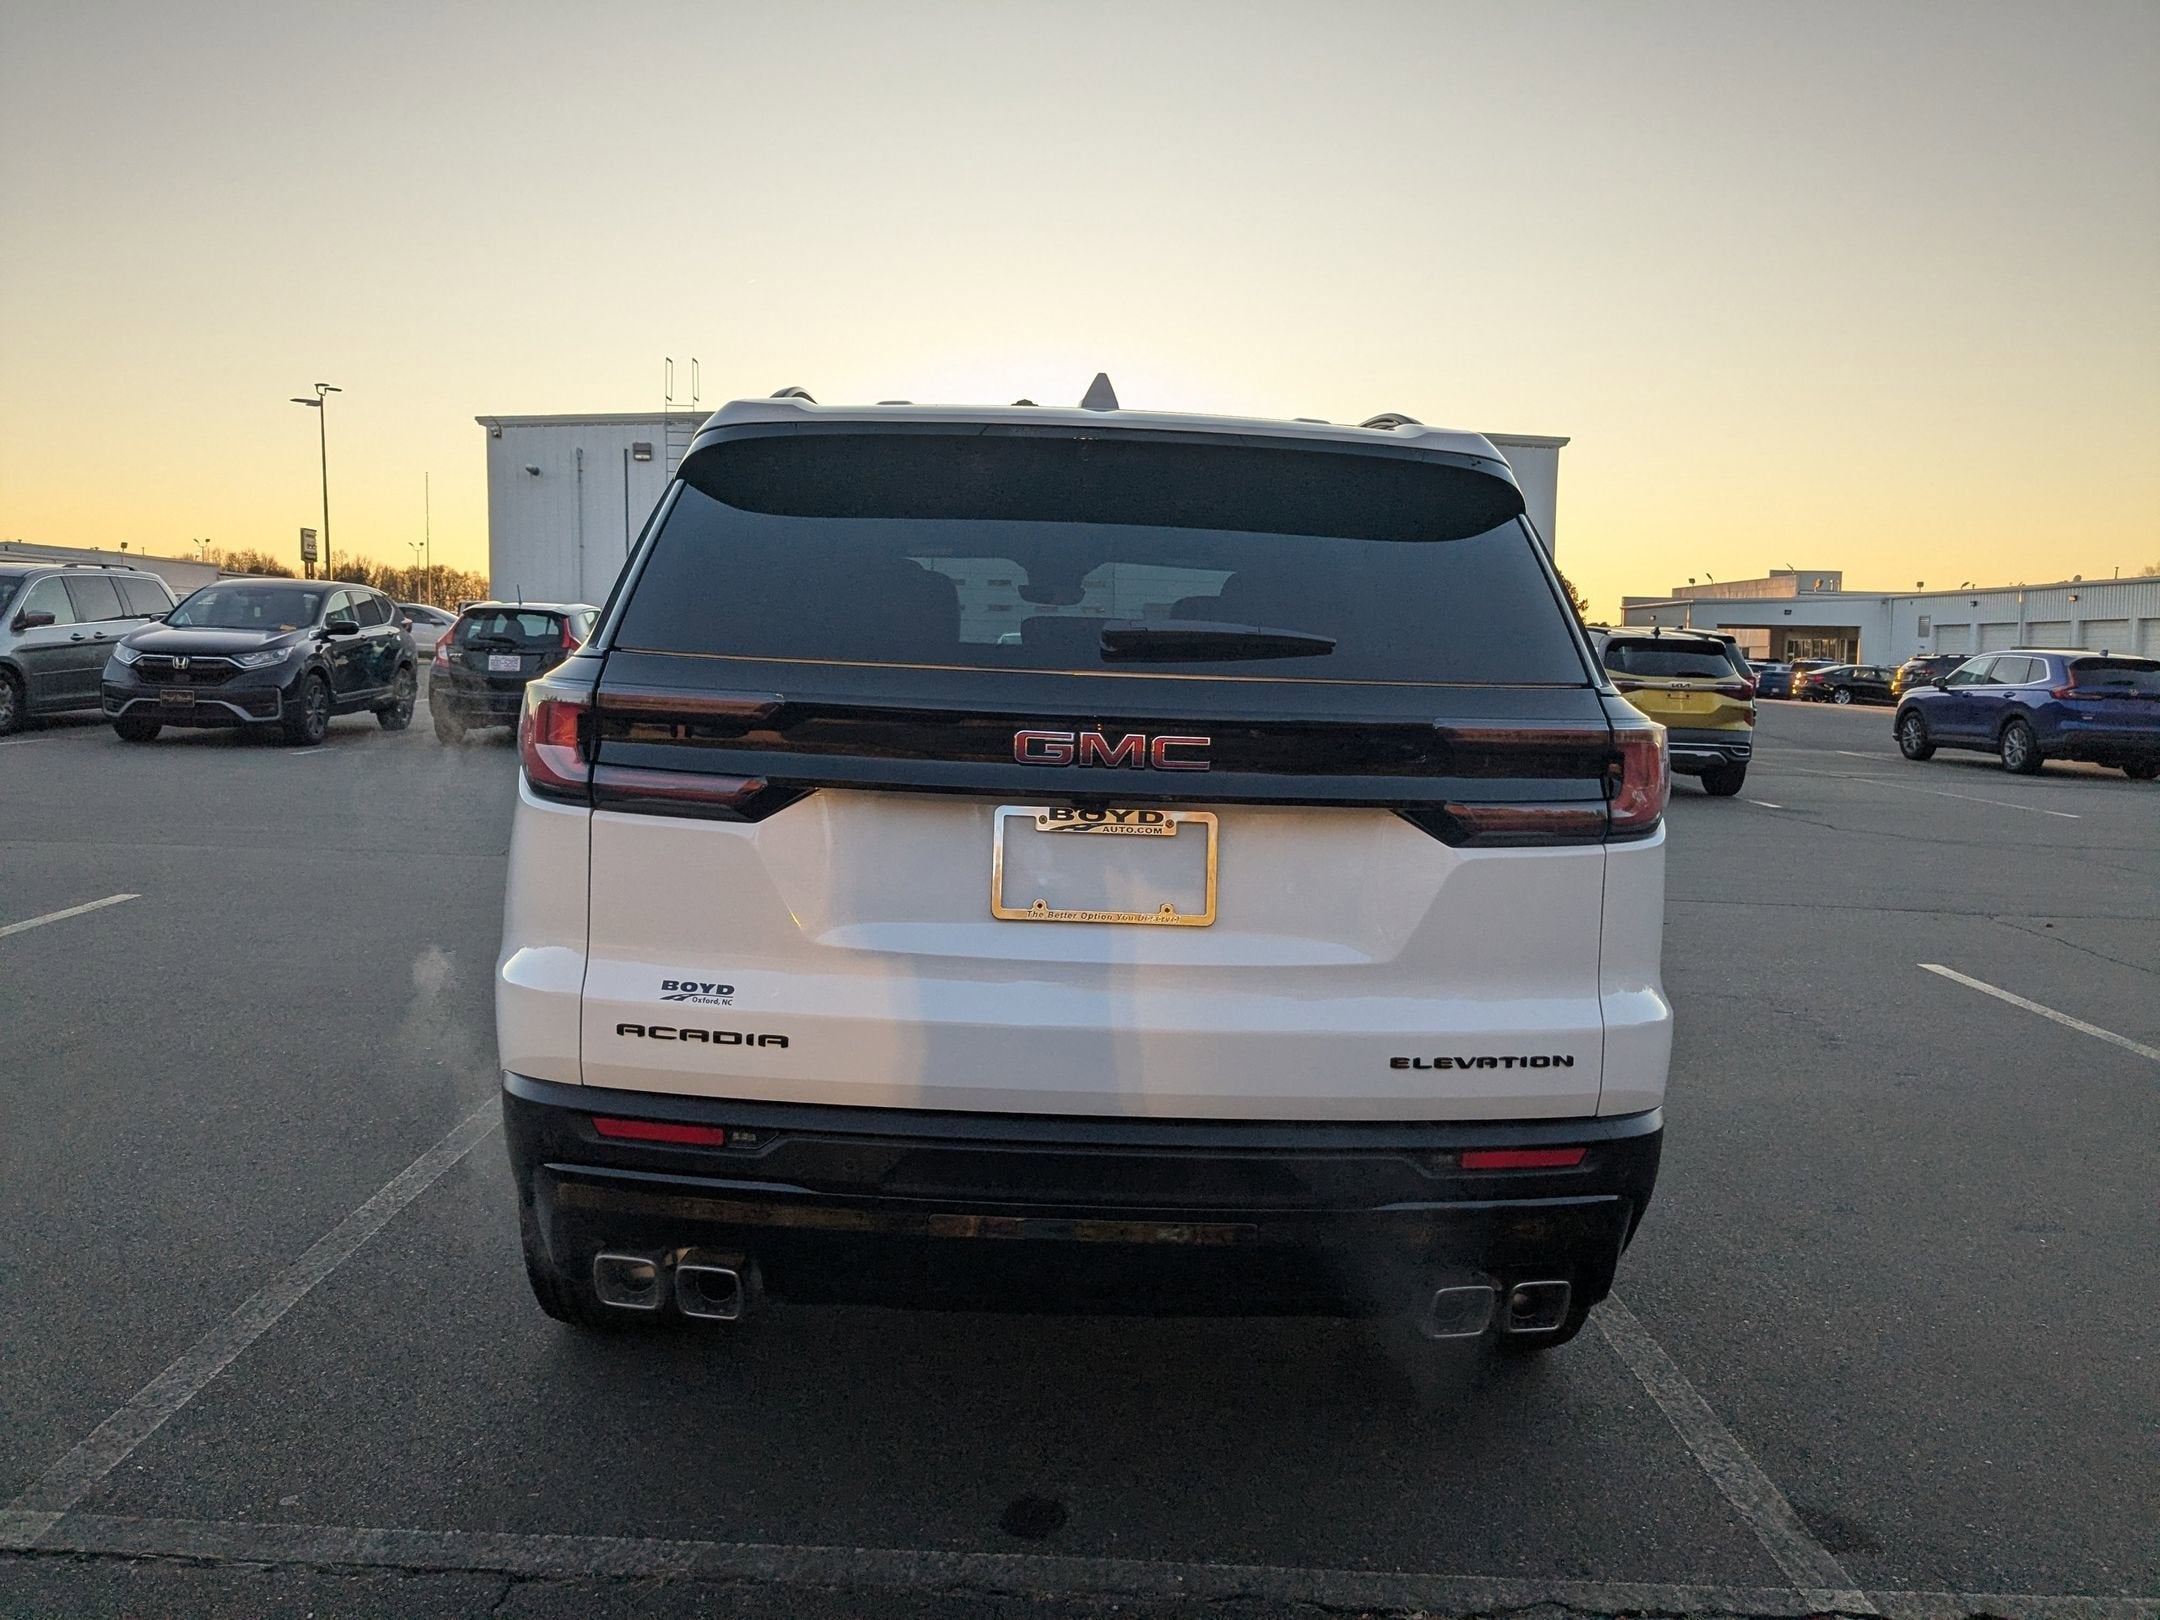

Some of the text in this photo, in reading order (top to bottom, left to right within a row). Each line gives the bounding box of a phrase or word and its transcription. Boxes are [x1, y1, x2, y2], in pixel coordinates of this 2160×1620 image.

[1014, 730, 1211, 770] GMC
[1048, 807, 1164, 824] BOYD
[1102, 825, 1163, 835] AUTO.COM
[1027, 910, 1044, 919] The
[1047, 911, 1077, 920] Better
[1080, 912, 1113, 922] Option
[1116, 913, 1134, 922] You
[661, 979, 735, 996] BOYD
[691, 996, 733, 1006] Oxford, NC
[616, 1023, 789, 1048] ACADIA
[1390, 1055, 1575, 1069] ELEVATION
